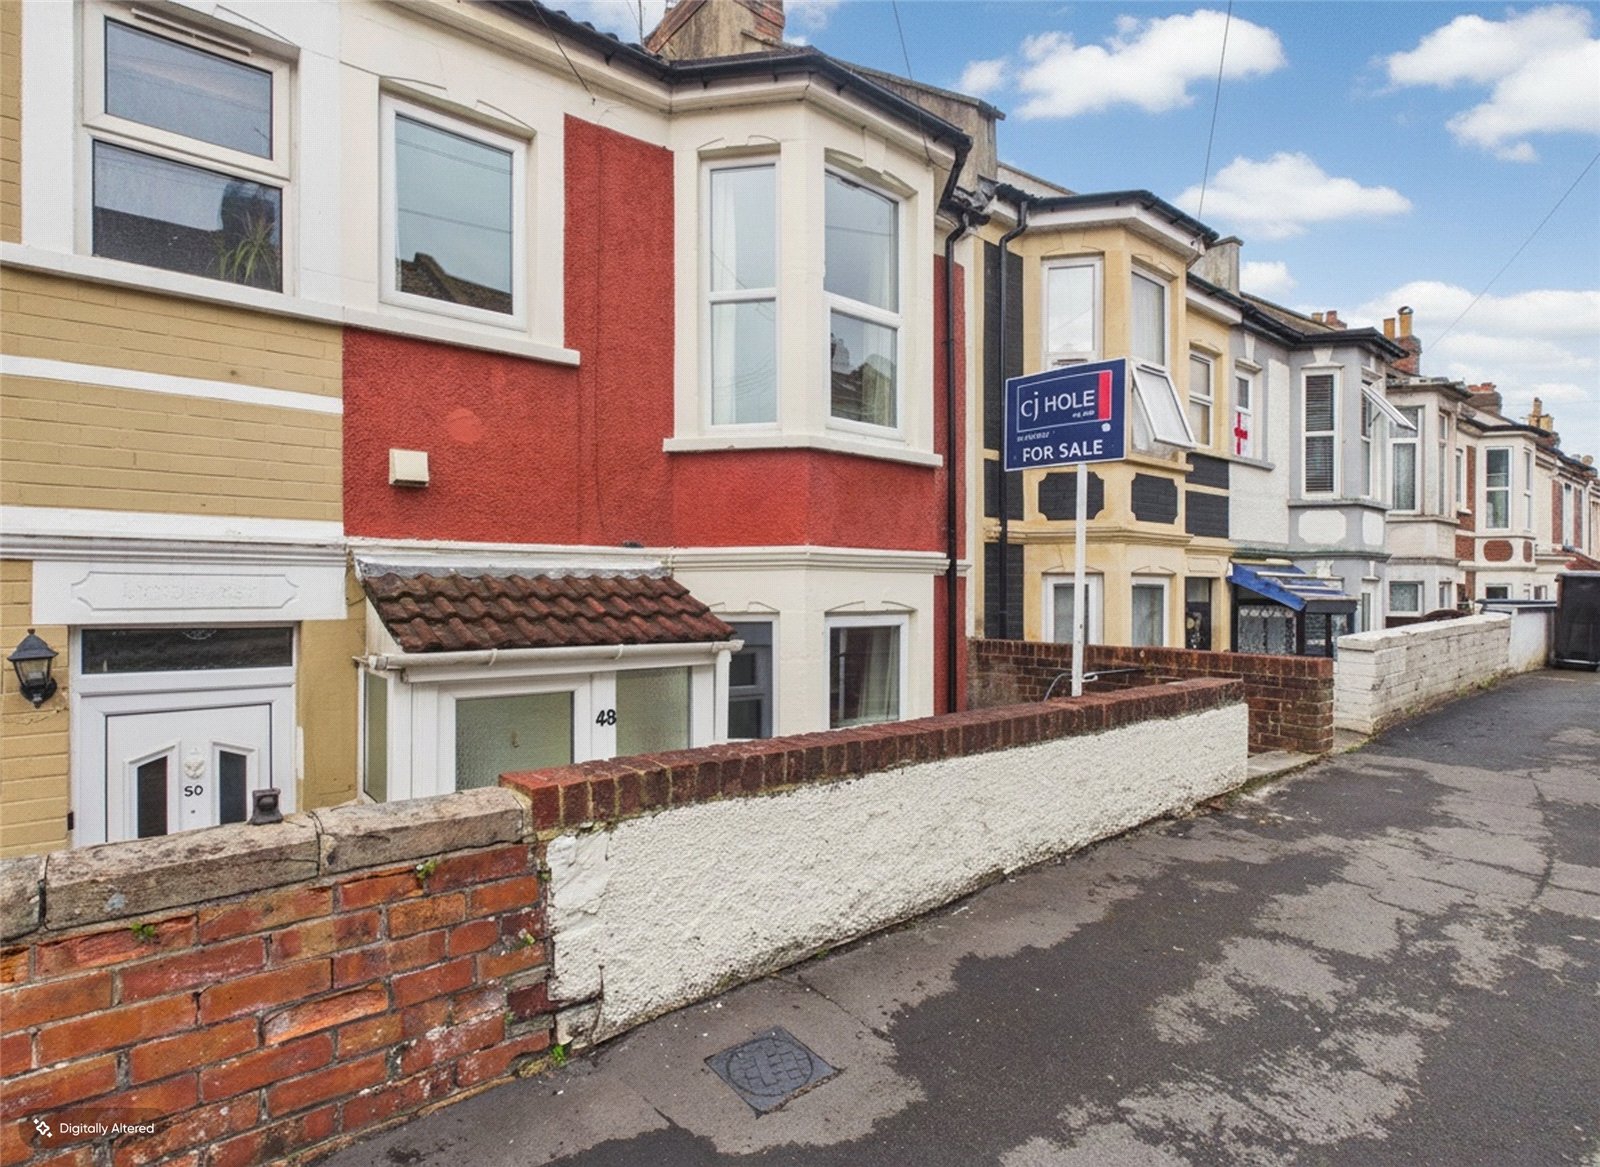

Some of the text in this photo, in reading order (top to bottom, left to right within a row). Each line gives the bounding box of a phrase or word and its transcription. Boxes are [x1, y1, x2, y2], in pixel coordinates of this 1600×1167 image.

[1044, 390, 1095, 413] HOLE
[1022, 439, 1103, 462] FOR SALE
[595, 708, 617, 727] 48
